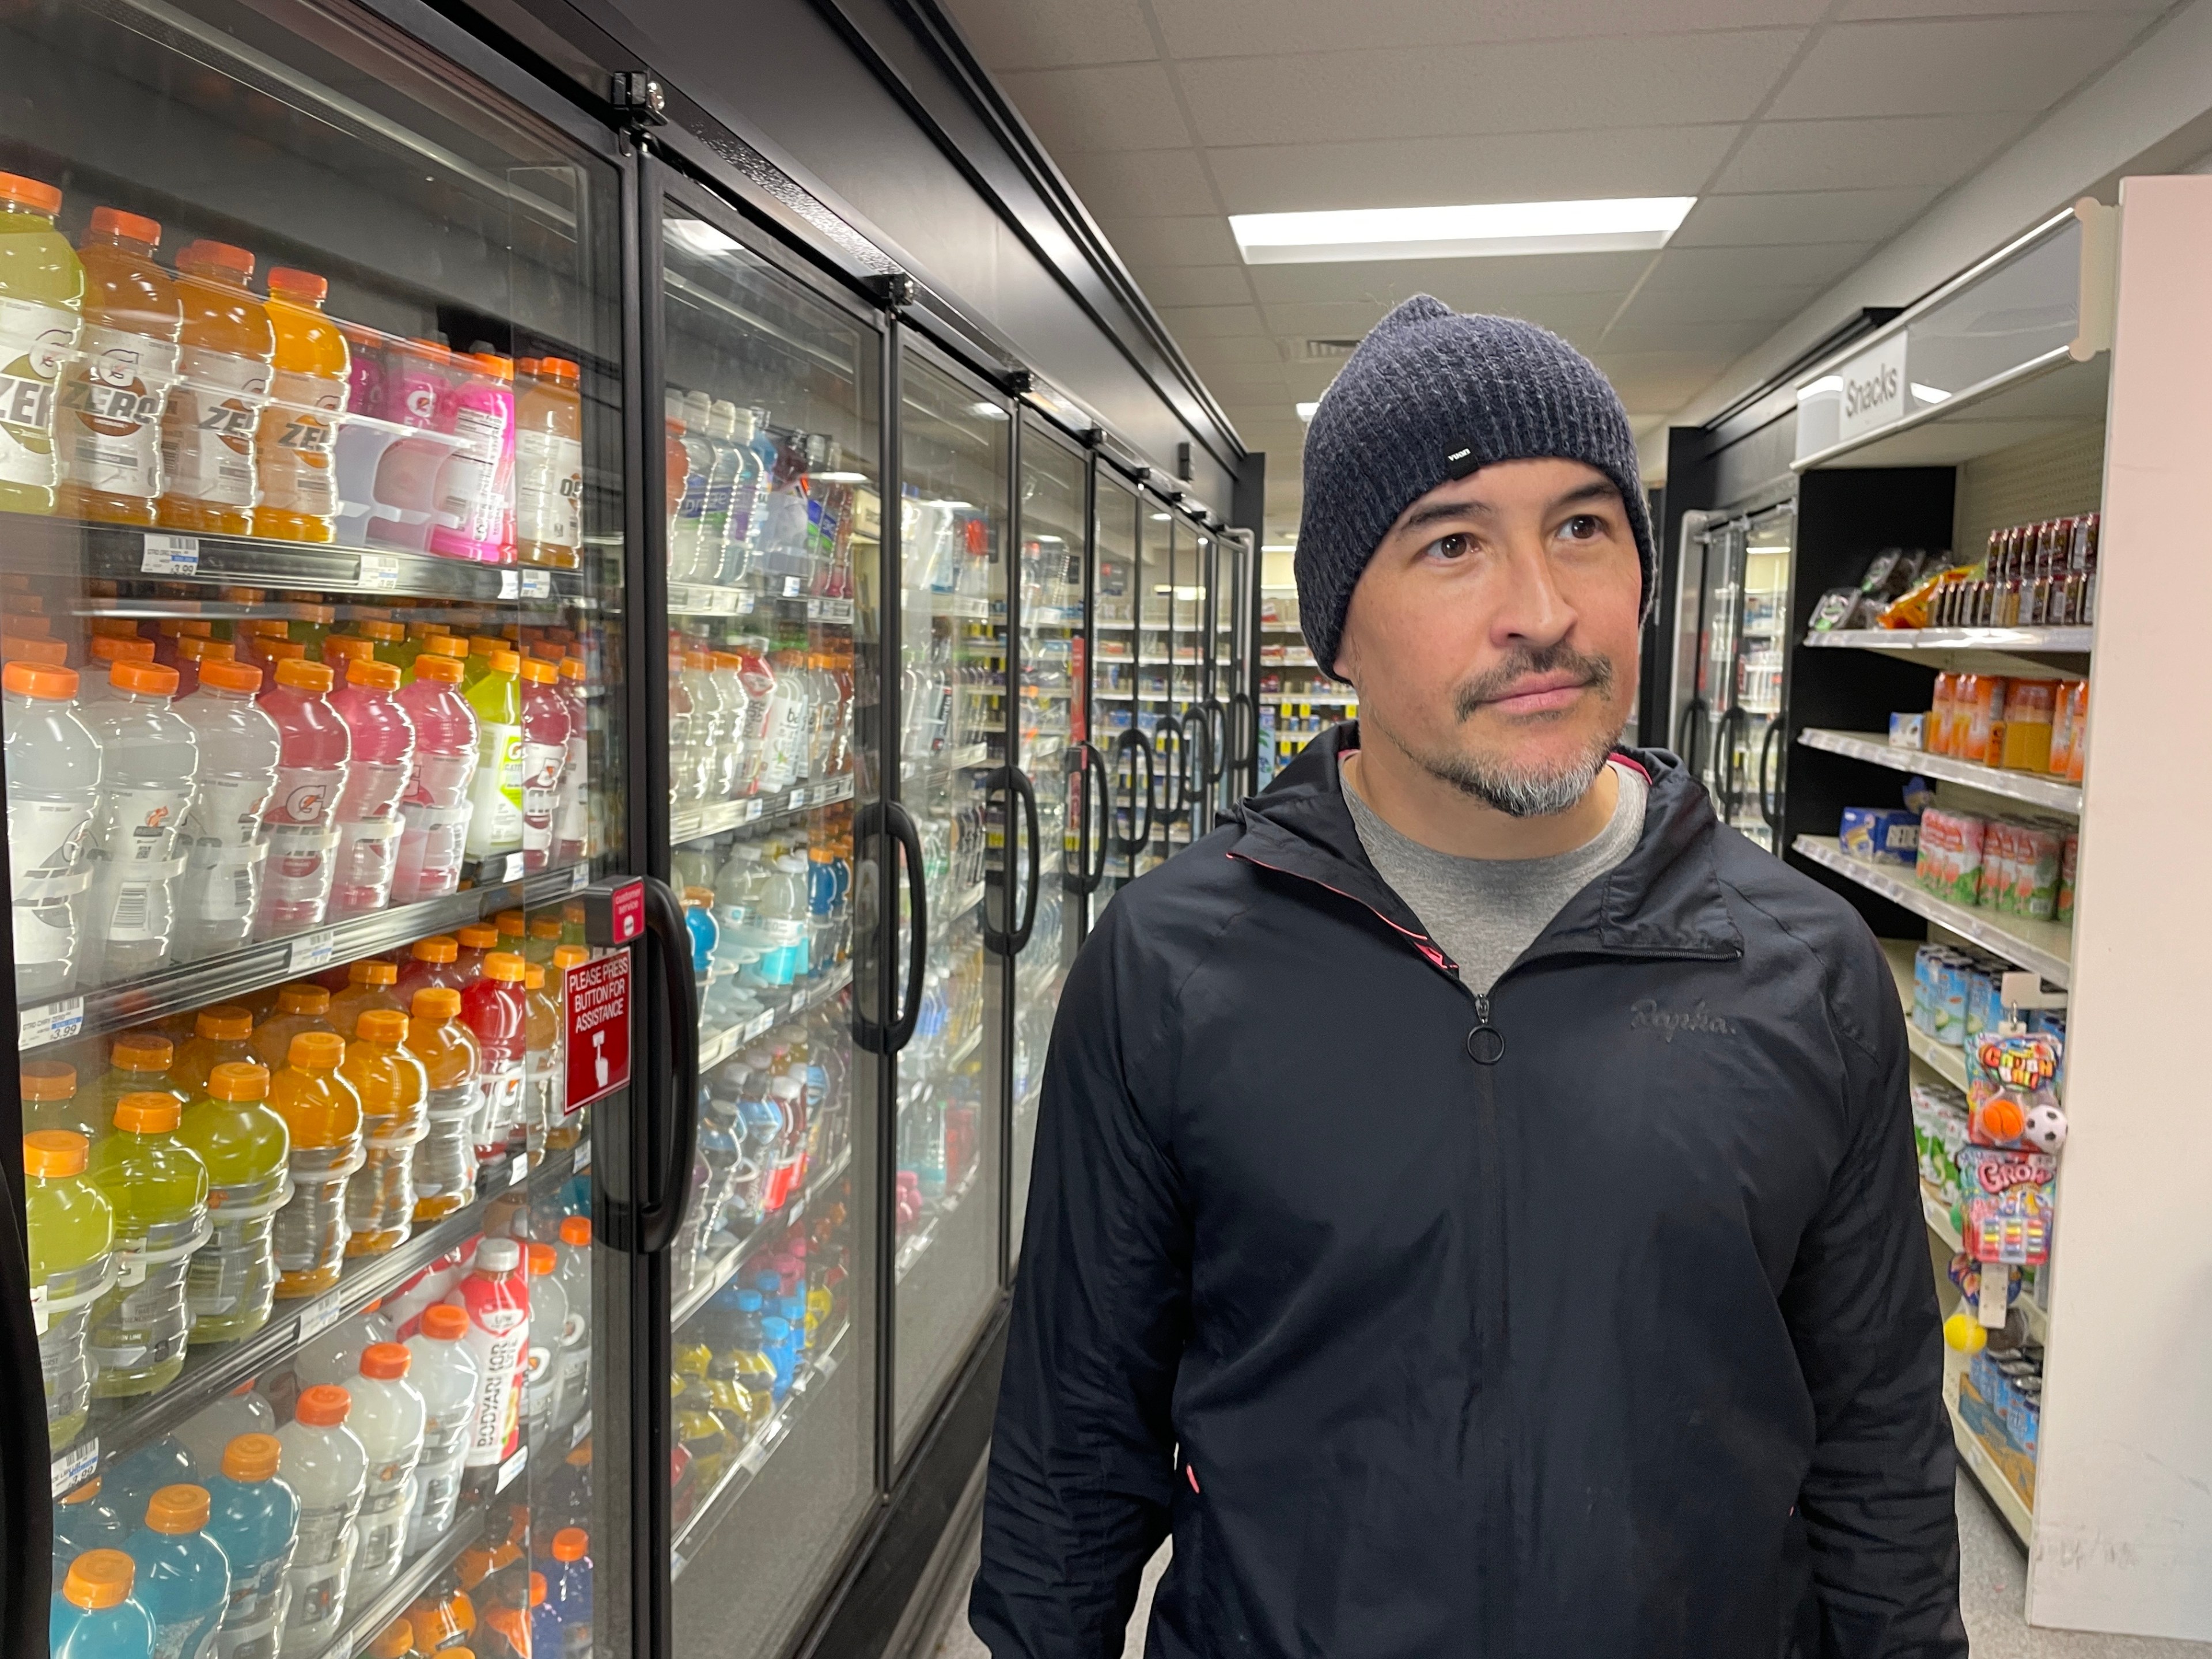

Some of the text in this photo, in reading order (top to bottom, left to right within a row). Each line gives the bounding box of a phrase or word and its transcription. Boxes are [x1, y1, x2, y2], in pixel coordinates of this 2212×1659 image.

[60, 380, 157, 425] ZERO
[1845, 362, 1896, 418] Snacks
[286, 785, 327, 821] G
[615, 888, 642, 904] customer
[619, 900, 639, 915] service
[569, 957, 628, 993] PLEASE PRESS
[575, 978, 625, 1013] BUTTON FOR
[575, 997, 624, 1033] ASSISTANCE
